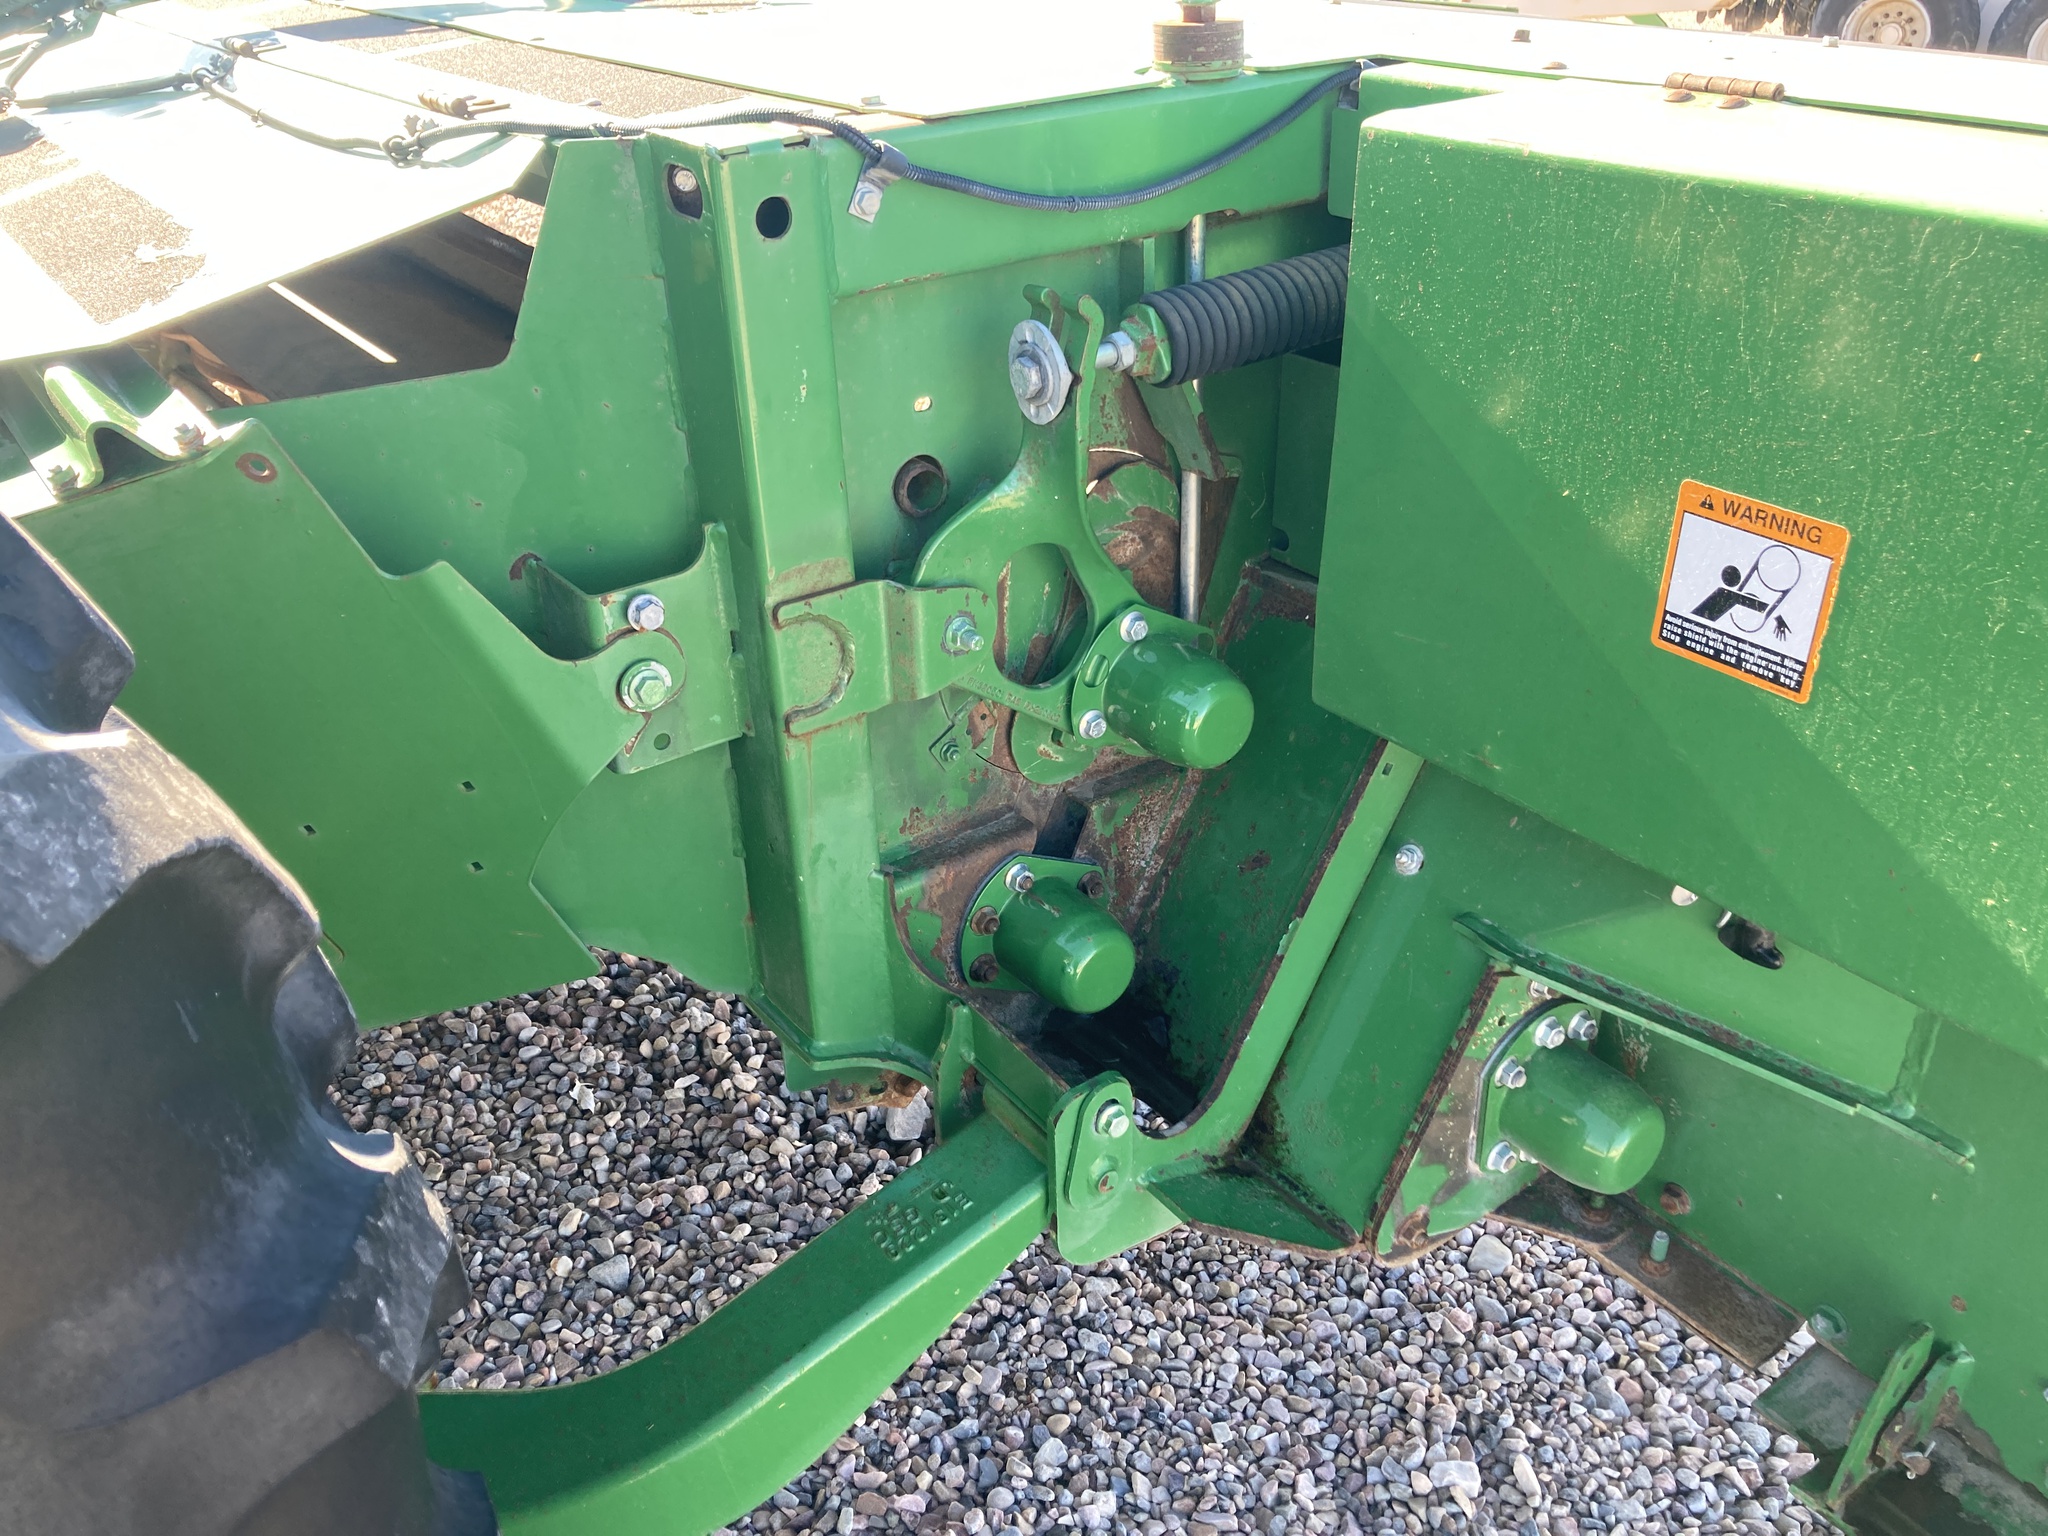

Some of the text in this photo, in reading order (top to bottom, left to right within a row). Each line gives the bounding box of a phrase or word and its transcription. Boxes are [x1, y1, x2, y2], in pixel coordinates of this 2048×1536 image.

[1723, 498, 1823, 545] WARNING
[1662, 630, 1799, 689] Stop engine and remove key.
[1663, 623, 1802, 681] raise shield with the engine running.
[1665, 614, 1804, 671] Avoid serious injury from entanglement. Never
